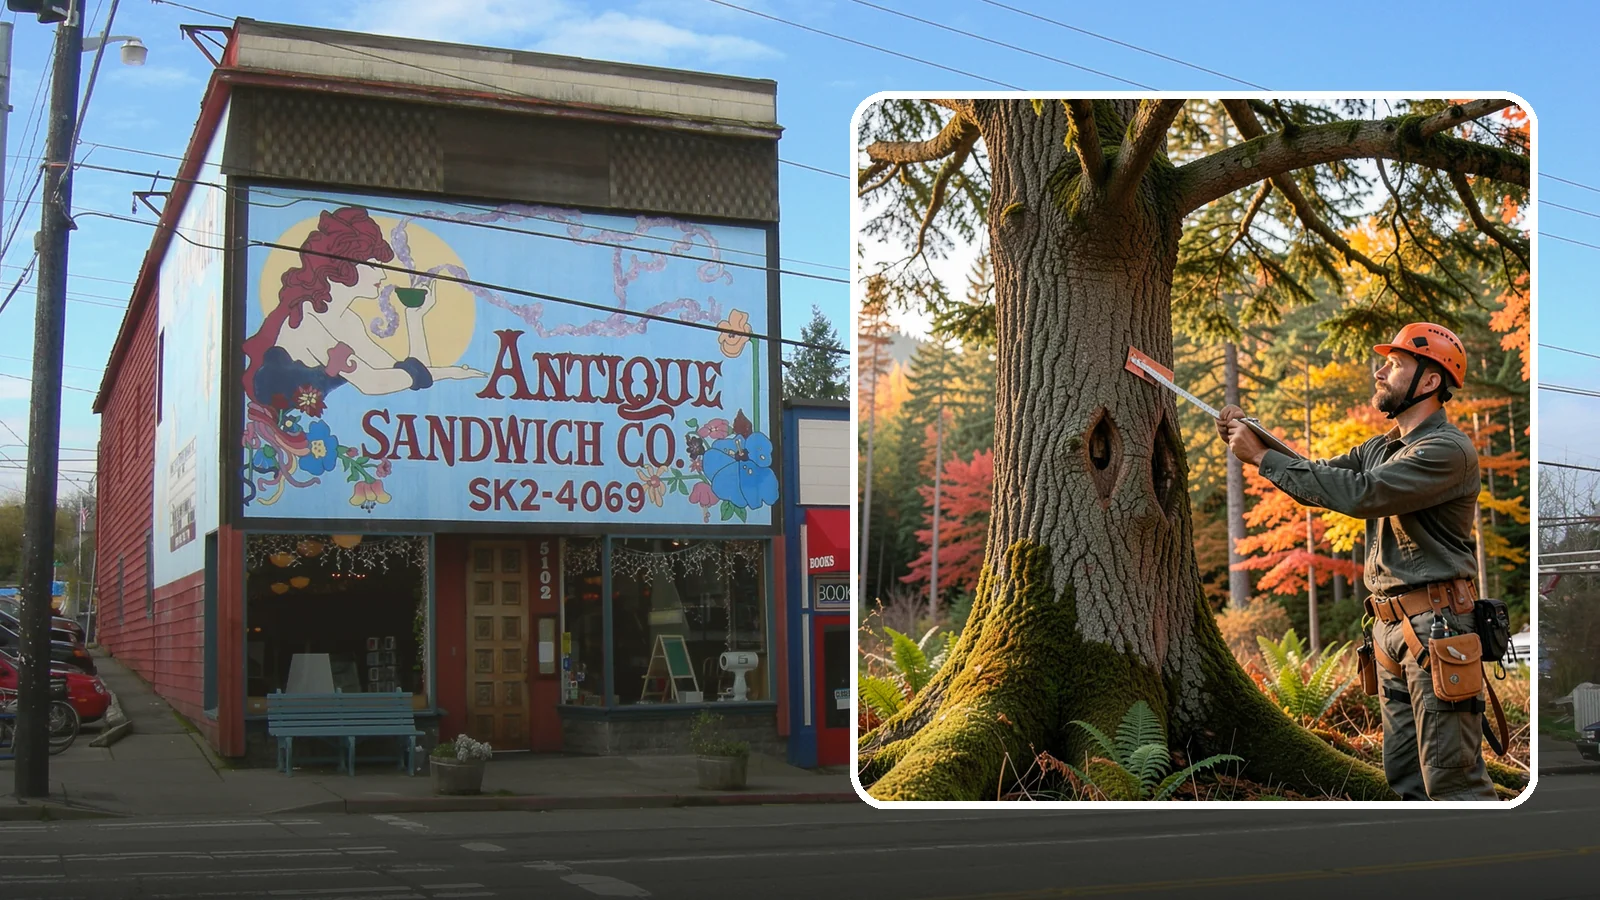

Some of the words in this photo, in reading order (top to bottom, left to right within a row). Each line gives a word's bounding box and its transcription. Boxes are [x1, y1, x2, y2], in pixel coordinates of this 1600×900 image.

[475, 329, 723, 421] ANTIQUE
[361, 408, 605, 467] SANDWICH
[617, 421, 685, 469] CO.
[468, 477, 646, 514] SK2-4069
[539, 541, 552, 600] 5102
[809, 555, 835, 569] BOOKS
